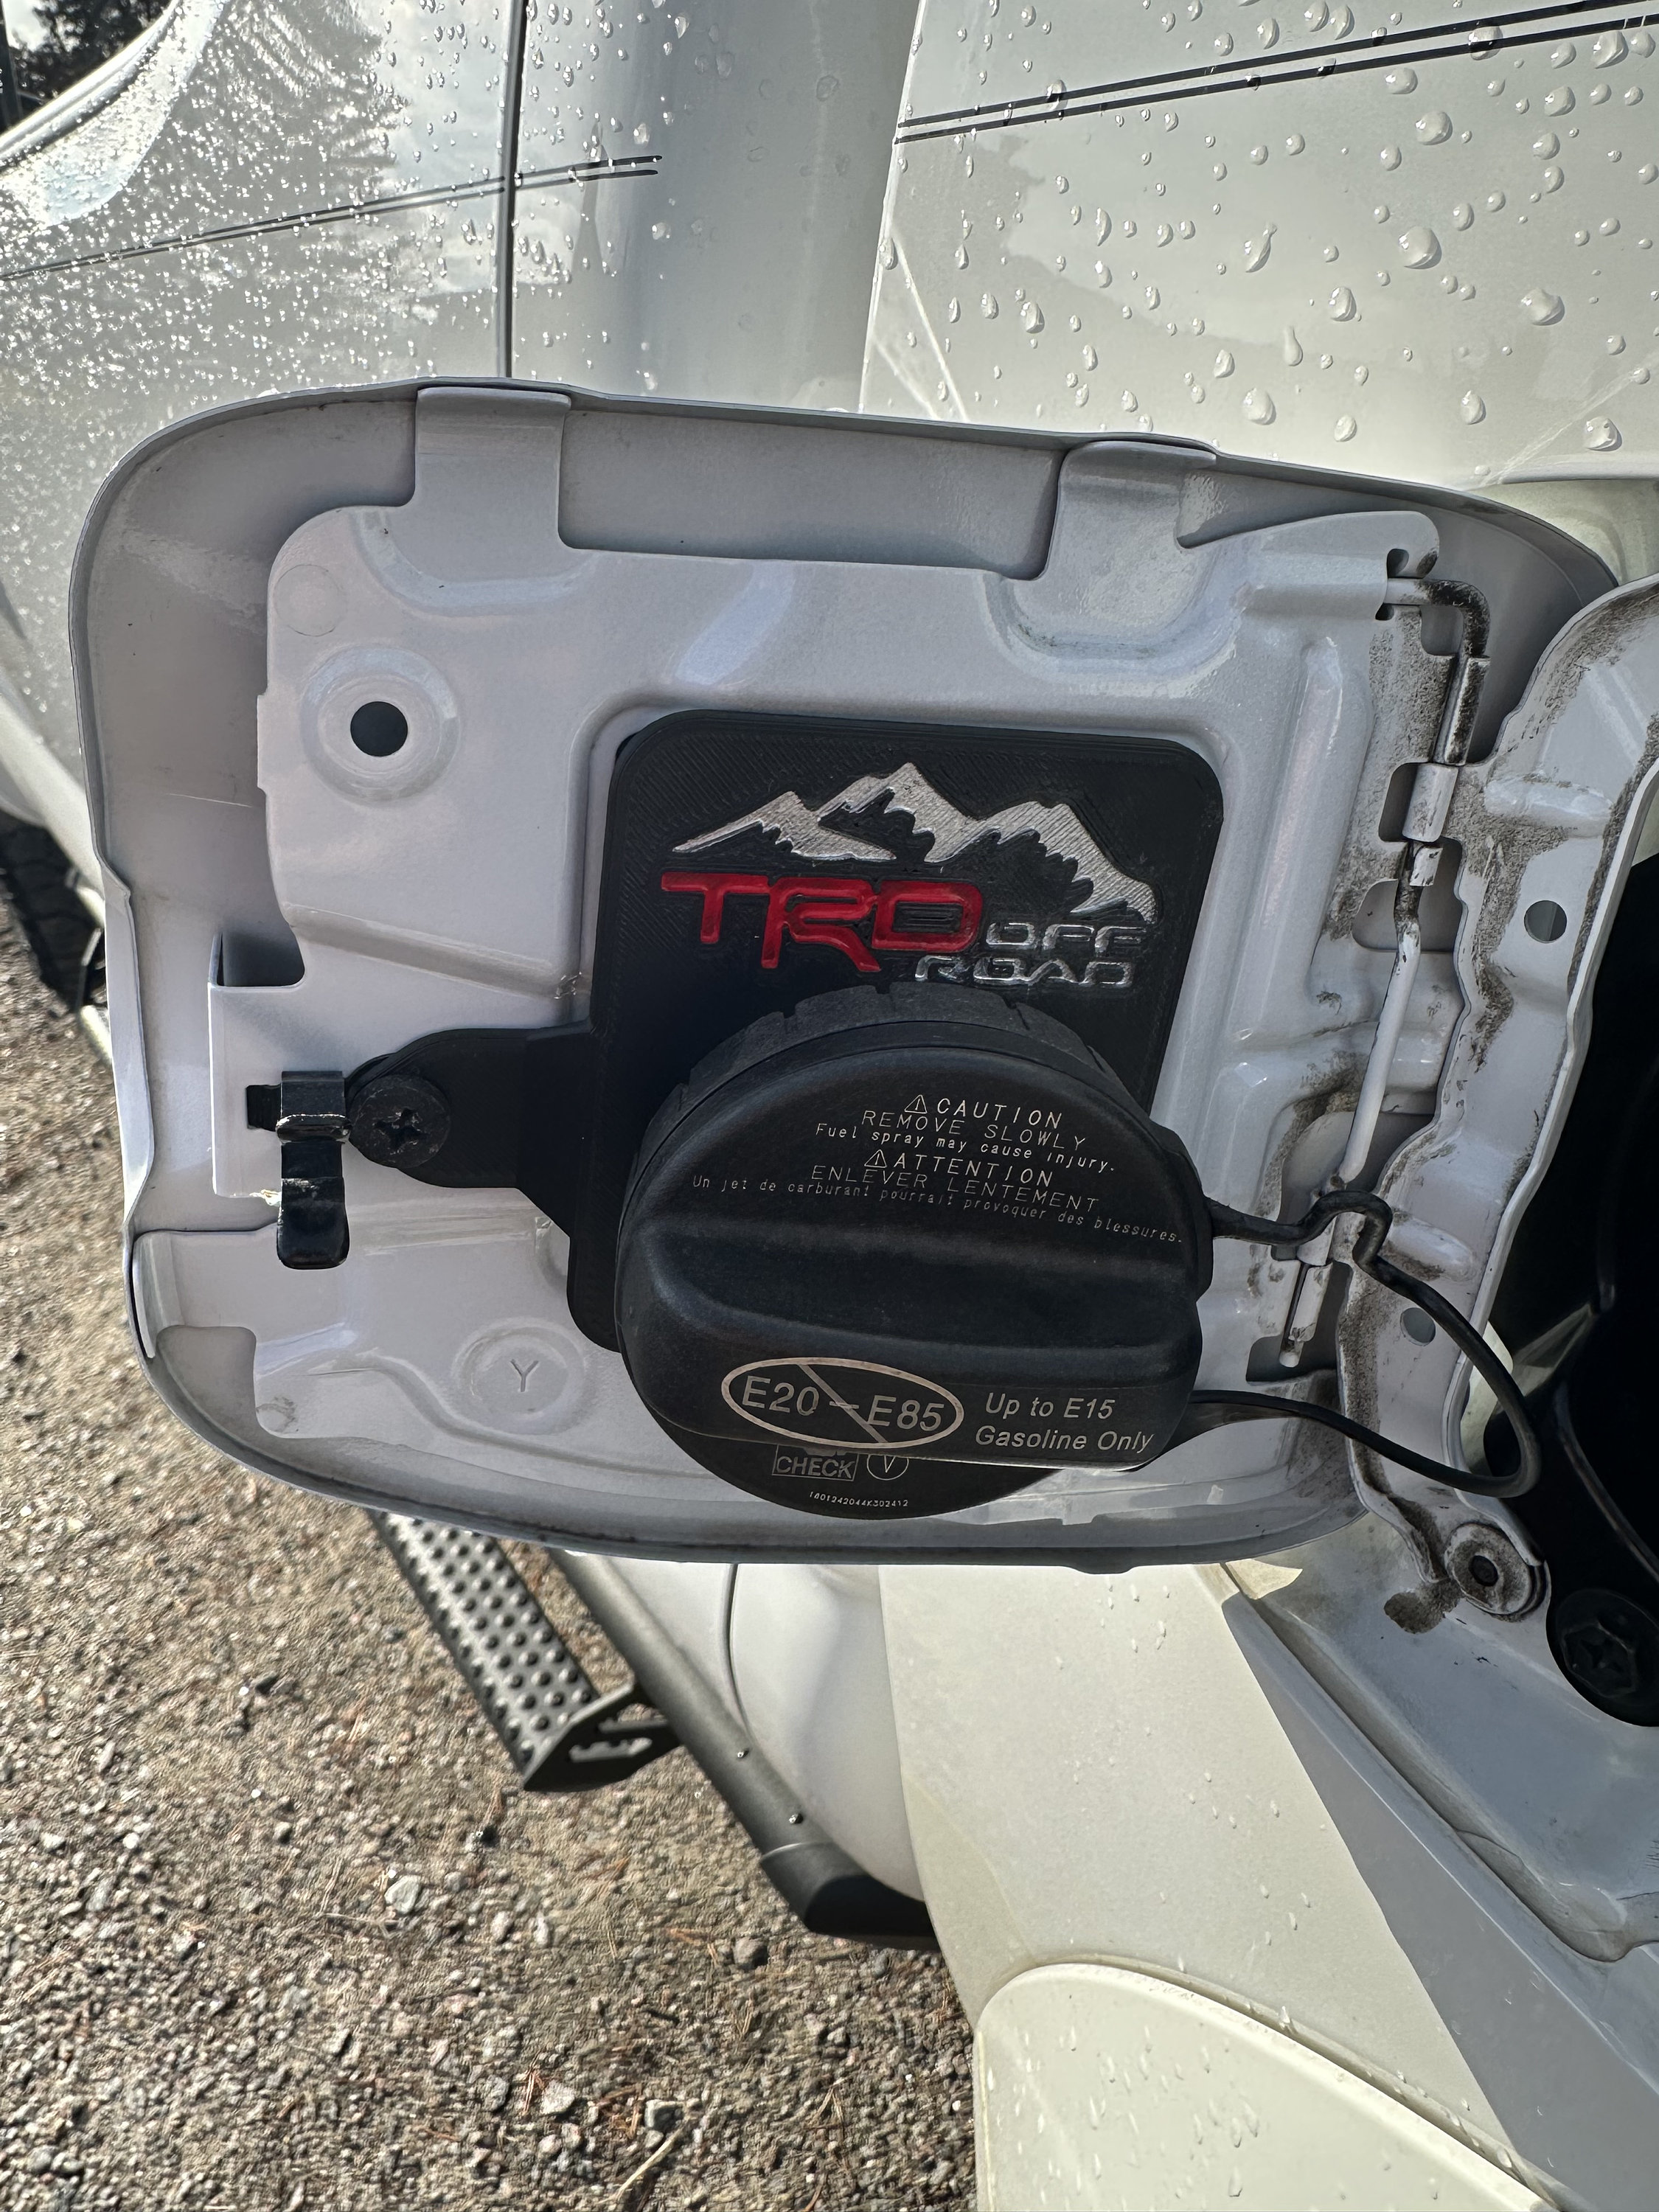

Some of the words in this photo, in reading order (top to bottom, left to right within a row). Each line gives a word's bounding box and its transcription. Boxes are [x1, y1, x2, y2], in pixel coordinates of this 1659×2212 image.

[661, 872, 983, 972] TRD
[986, 922, 1146, 956] OFF
[915, 954, 1134, 987] ROAD
[861, 1110, 965, 1134] REMOVE
[984, 1124, 1086, 1151] SLOWLY
[936, 1098, 1062, 1129] CAUTION
[815, 1123, 858, 1138] Fuel
[871, 1131, 925, 1148] spray
[936, 1138, 967, 1153] may
[981, 1144, 1032, 1158] cause
[1046, 1152, 1115, 1174] injury.
[893, 1152, 1053, 1187] ATTENTION
[811, 1165, 928, 1189] ENLEVER
[947, 1177, 1100, 1212] LENTEMENT
[692, 1175, 710, 1188] Un
[759, 1179, 776, 1192] de
[787, 1182, 869, 1197] carburant
[879, 1189, 953, 1206] pourrait
[963, 1198, 1047, 1219] provoquer
[1058, 1211, 1084, 1225] des
[1094, 1217, 1183, 1243] blessures.
[985, 1392, 1020, 1419] Up
[1030, 1397, 1054, 1417] to
[1064, 1397, 1116, 1419] E15
[975, 1425, 1088, 1450] Gasoline
[1097, 1430, 1155, 1454] Only
[776, 1455, 855, 1479] CHECK
